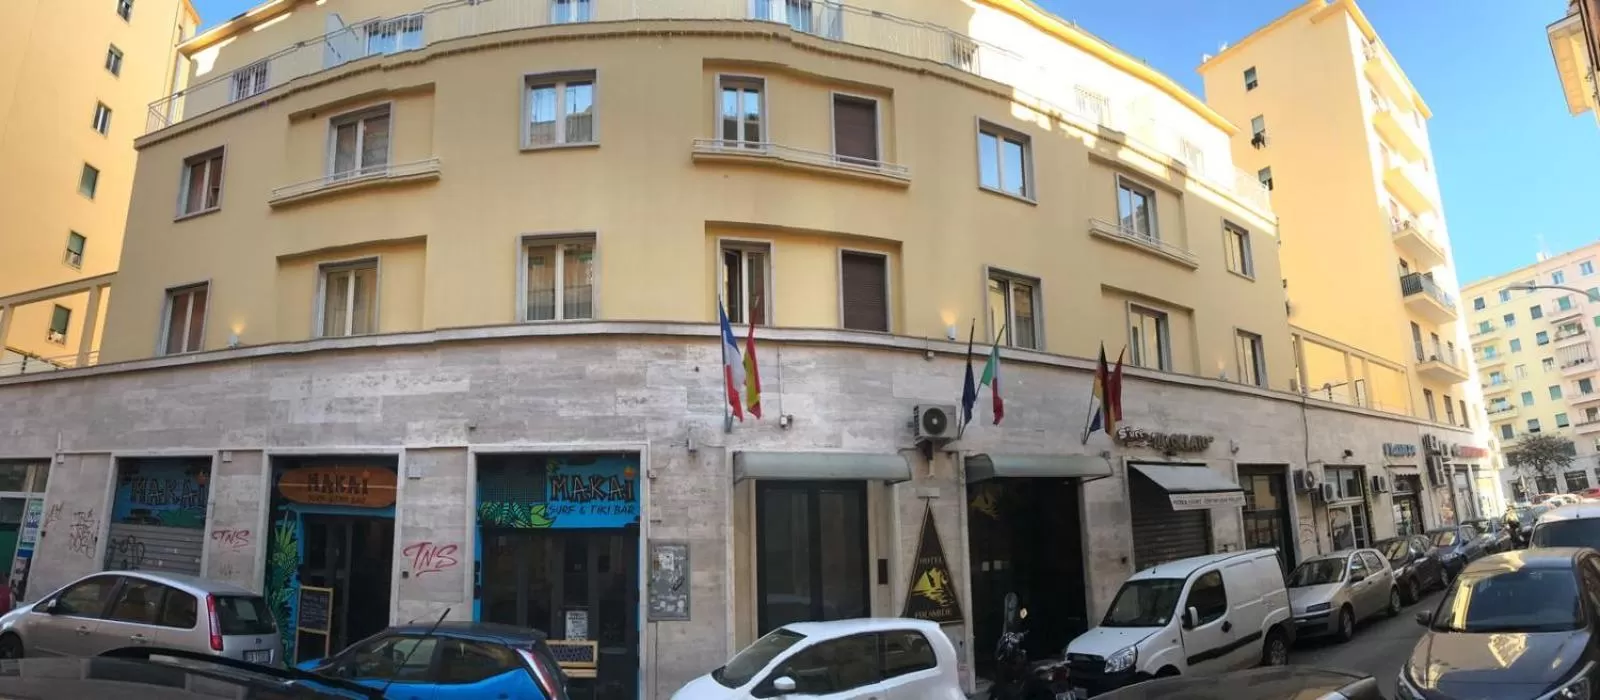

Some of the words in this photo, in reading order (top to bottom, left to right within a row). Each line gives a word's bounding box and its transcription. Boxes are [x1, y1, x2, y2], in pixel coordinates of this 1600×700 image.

[548, 504, 576, 516] SURF
[614, 504, 636, 515] BAR
[403, 541, 458, 570] TNS
